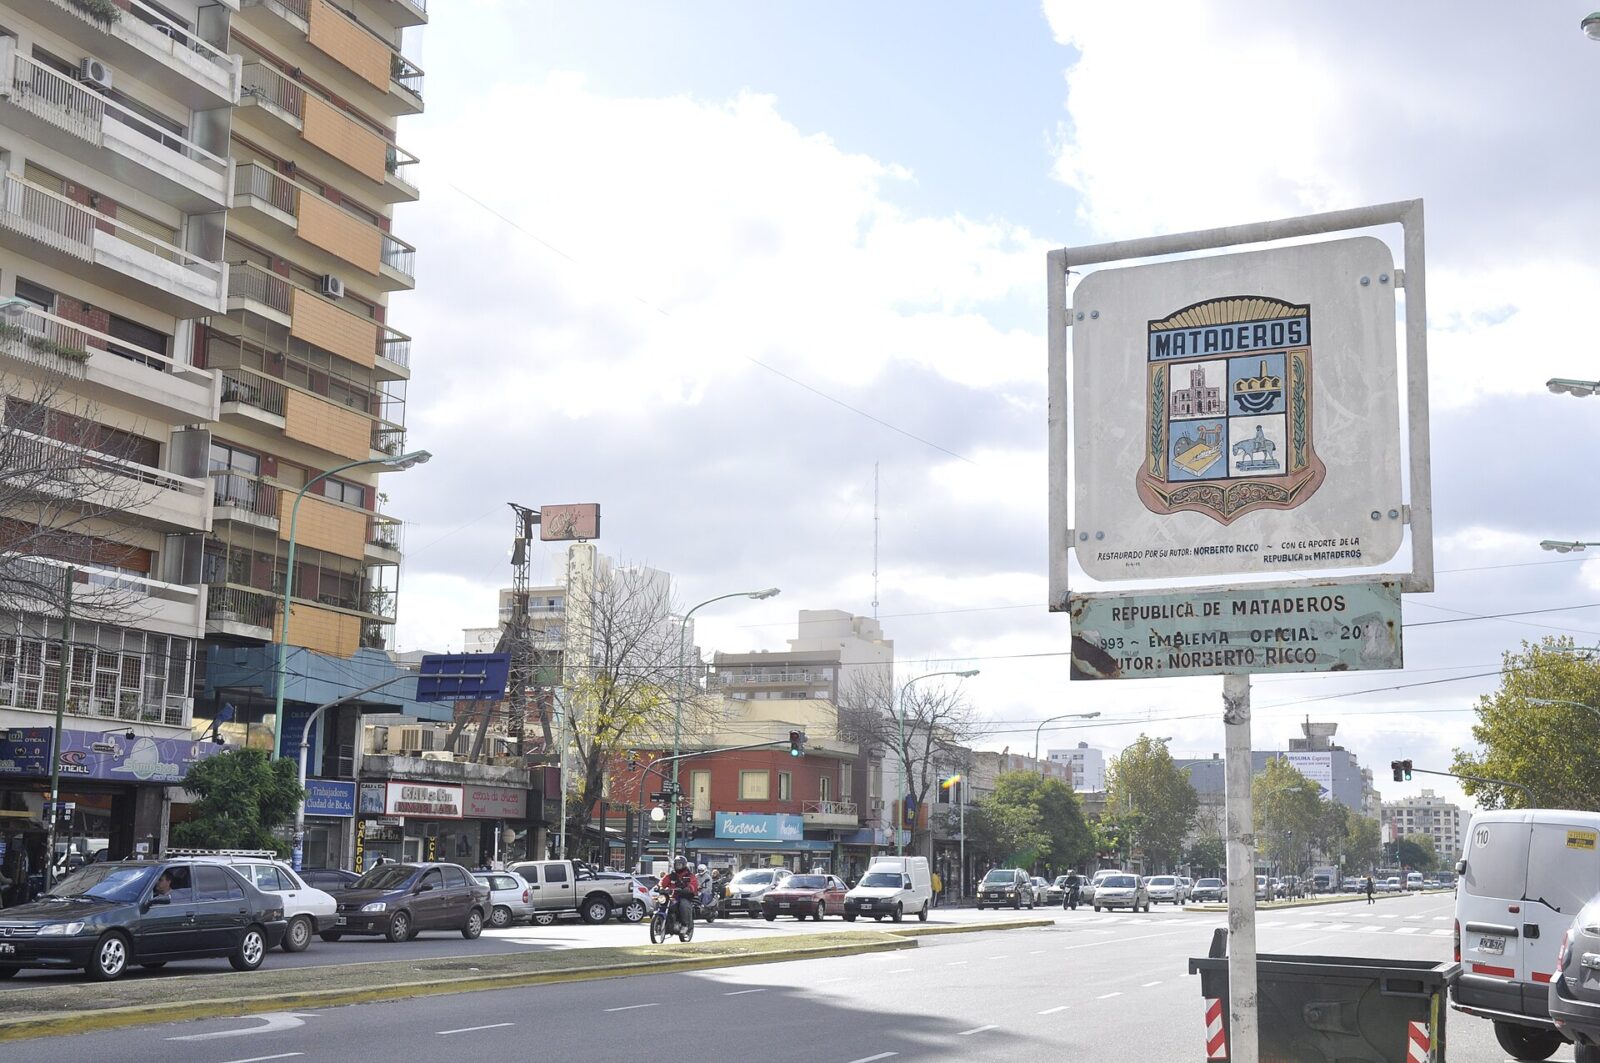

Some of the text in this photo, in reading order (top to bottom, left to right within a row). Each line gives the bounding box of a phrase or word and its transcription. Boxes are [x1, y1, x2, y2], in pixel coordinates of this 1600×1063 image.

[1155, 320, 1301, 357] MATADEROS
[1097, 537, 1360, 561] RESTAURADO POR SU AUTOR: NORBERTO RICCO CON EL APORTE DE LA
[1263, 552, 1304, 563] REPUBLICA
[1313, 549, 1362, 561] MATADEROS
[1112, 595, 1346, 622] REPUBLICA DE MATADEROS
[1100, 637, 1124, 650] 993
[1149, 631, 1230, 649] EMBLEMA
[1250, 627, 1319, 643] OFICIAL
[1116, 647, 1317, 671] UTOR: NORBERTO RICCO
[312, 786, 349, 798] Trabajadores
[306, 799, 327, 809] Ciudad
[327, 800, 335, 808] de
[722, 819, 768, 834] Personal
[1476, 829, 1489, 845] 110
[354, 820, 366, 873] GALPON
